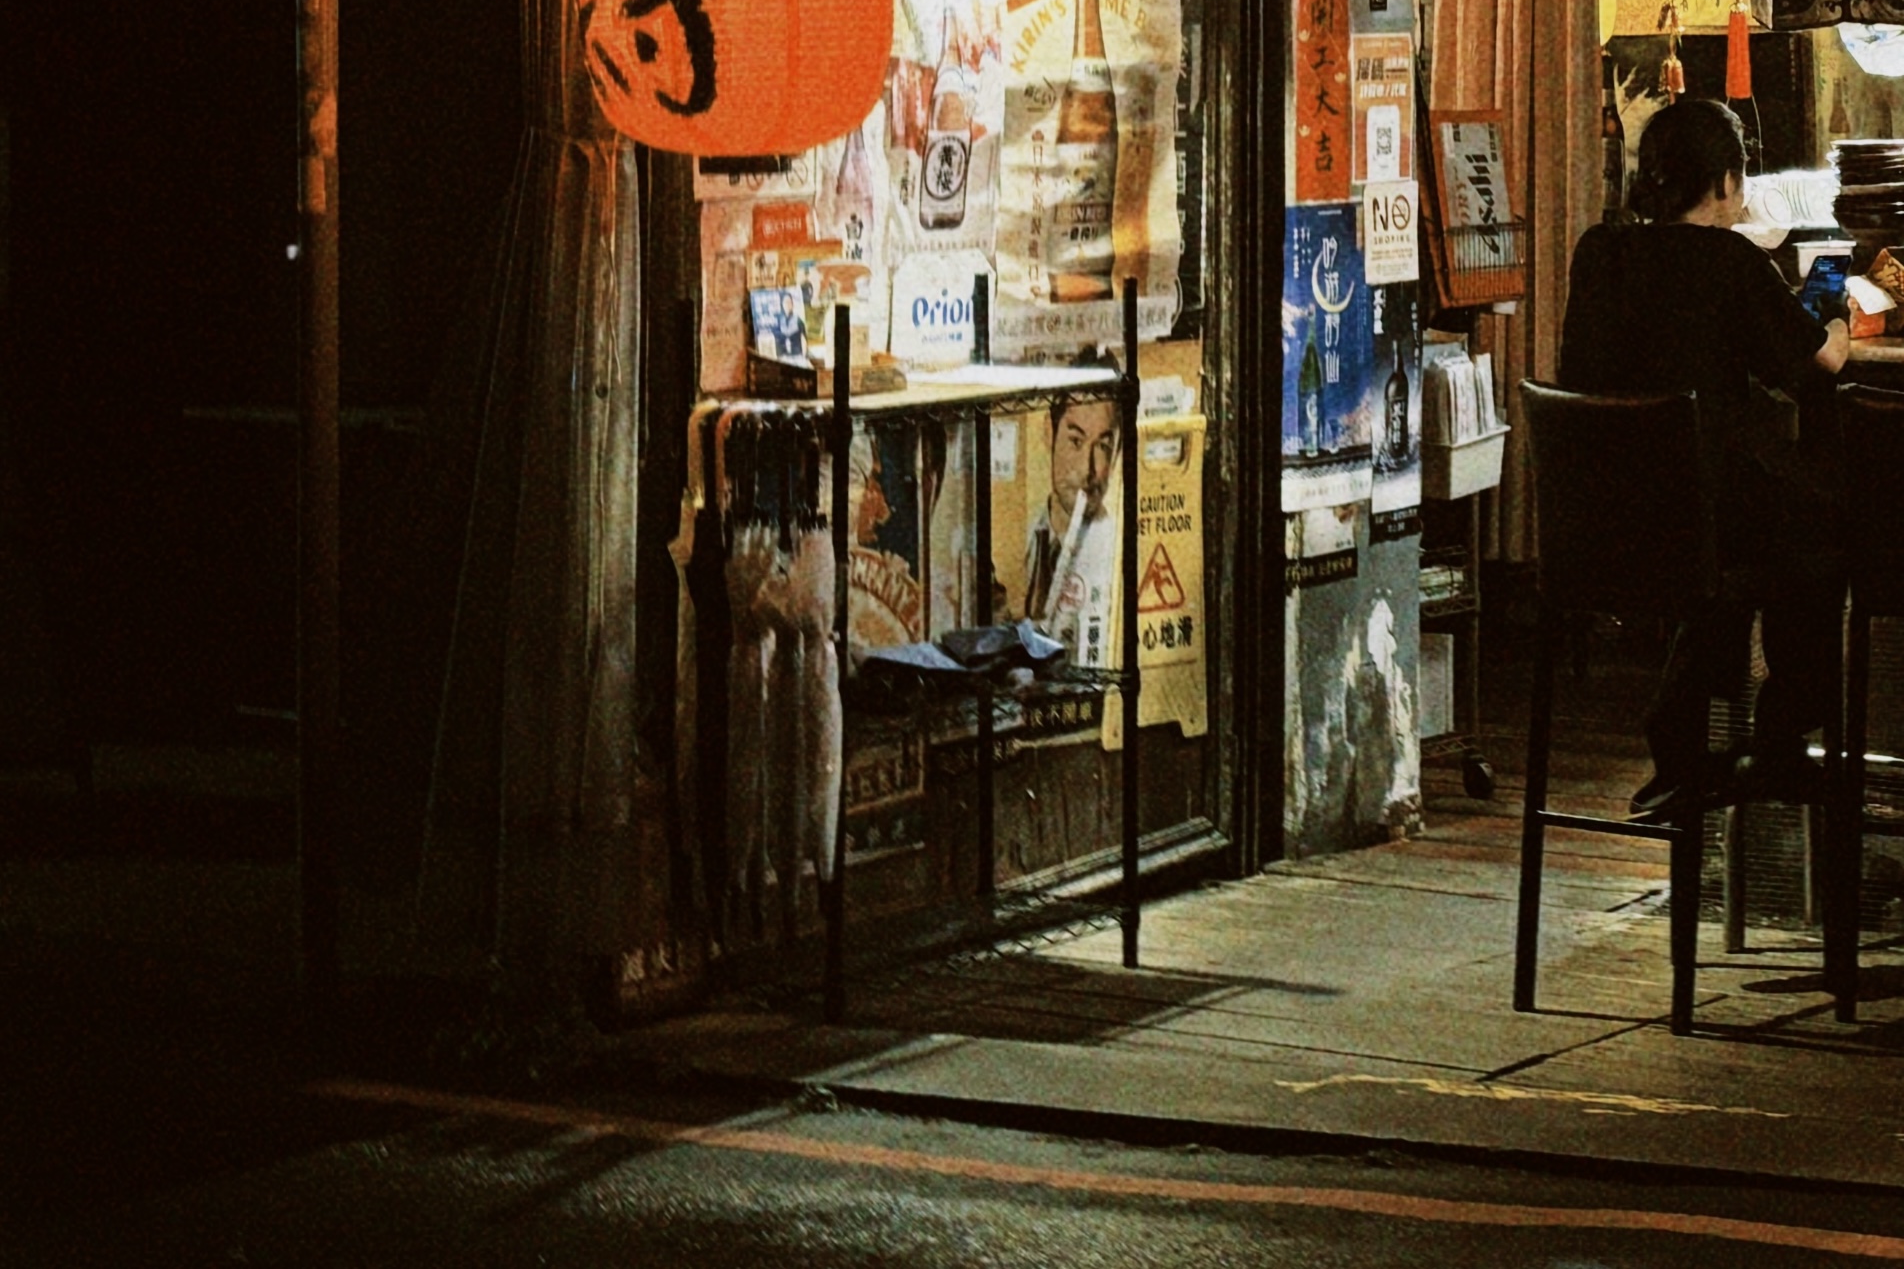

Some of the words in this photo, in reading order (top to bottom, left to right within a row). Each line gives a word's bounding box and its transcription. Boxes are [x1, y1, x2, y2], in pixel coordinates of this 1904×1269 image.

[1372, 194, 1411, 231] NO
[1464, 154, 1500, 255] Asahi
[1139, 492, 1186, 515] CAUTION
[1155, 514, 1193, 535] FLOOR
[1138, 615, 1194, 651] 心地滑
